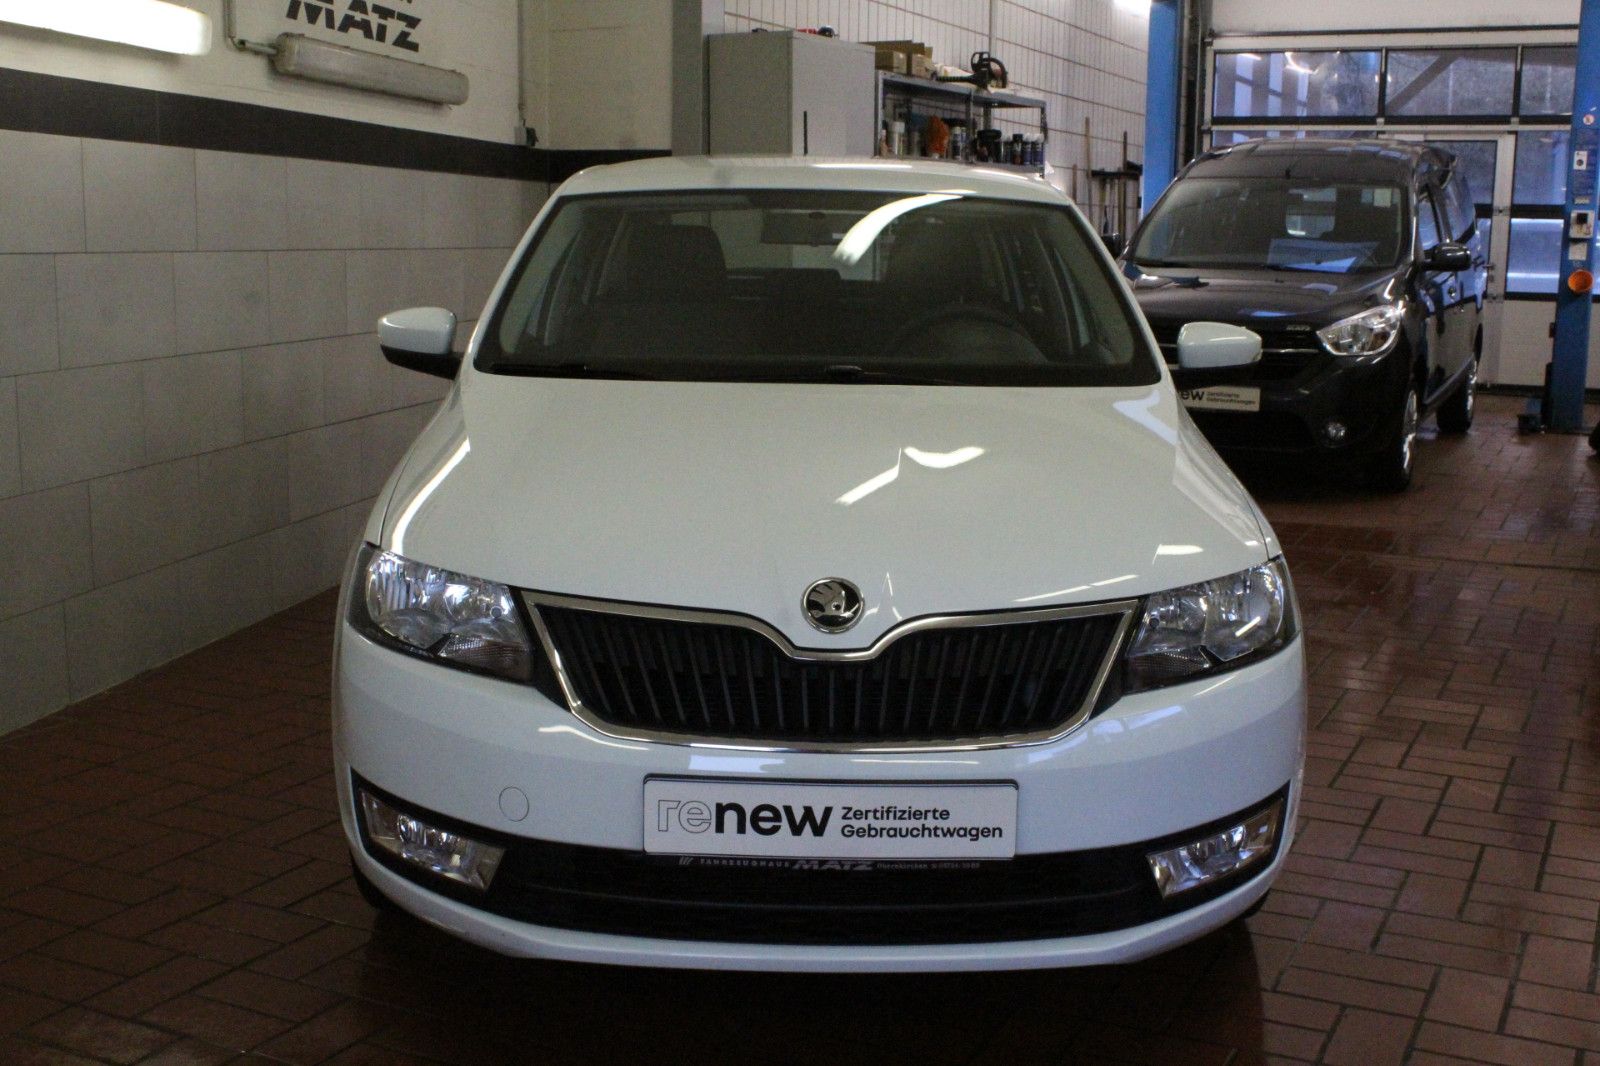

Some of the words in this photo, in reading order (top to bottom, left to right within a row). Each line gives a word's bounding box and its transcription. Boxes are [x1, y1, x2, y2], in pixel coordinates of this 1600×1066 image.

[285, 0, 422, 53] MATZ
[1179, 391, 1205, 400] ew
[657, 799, 834, 837] renew
[841, 806, 951, 821] Zertifizierte
[841, 823, 1003, 842] Gebrauchtwagen
[791, 860, 873, 871] MATZ
